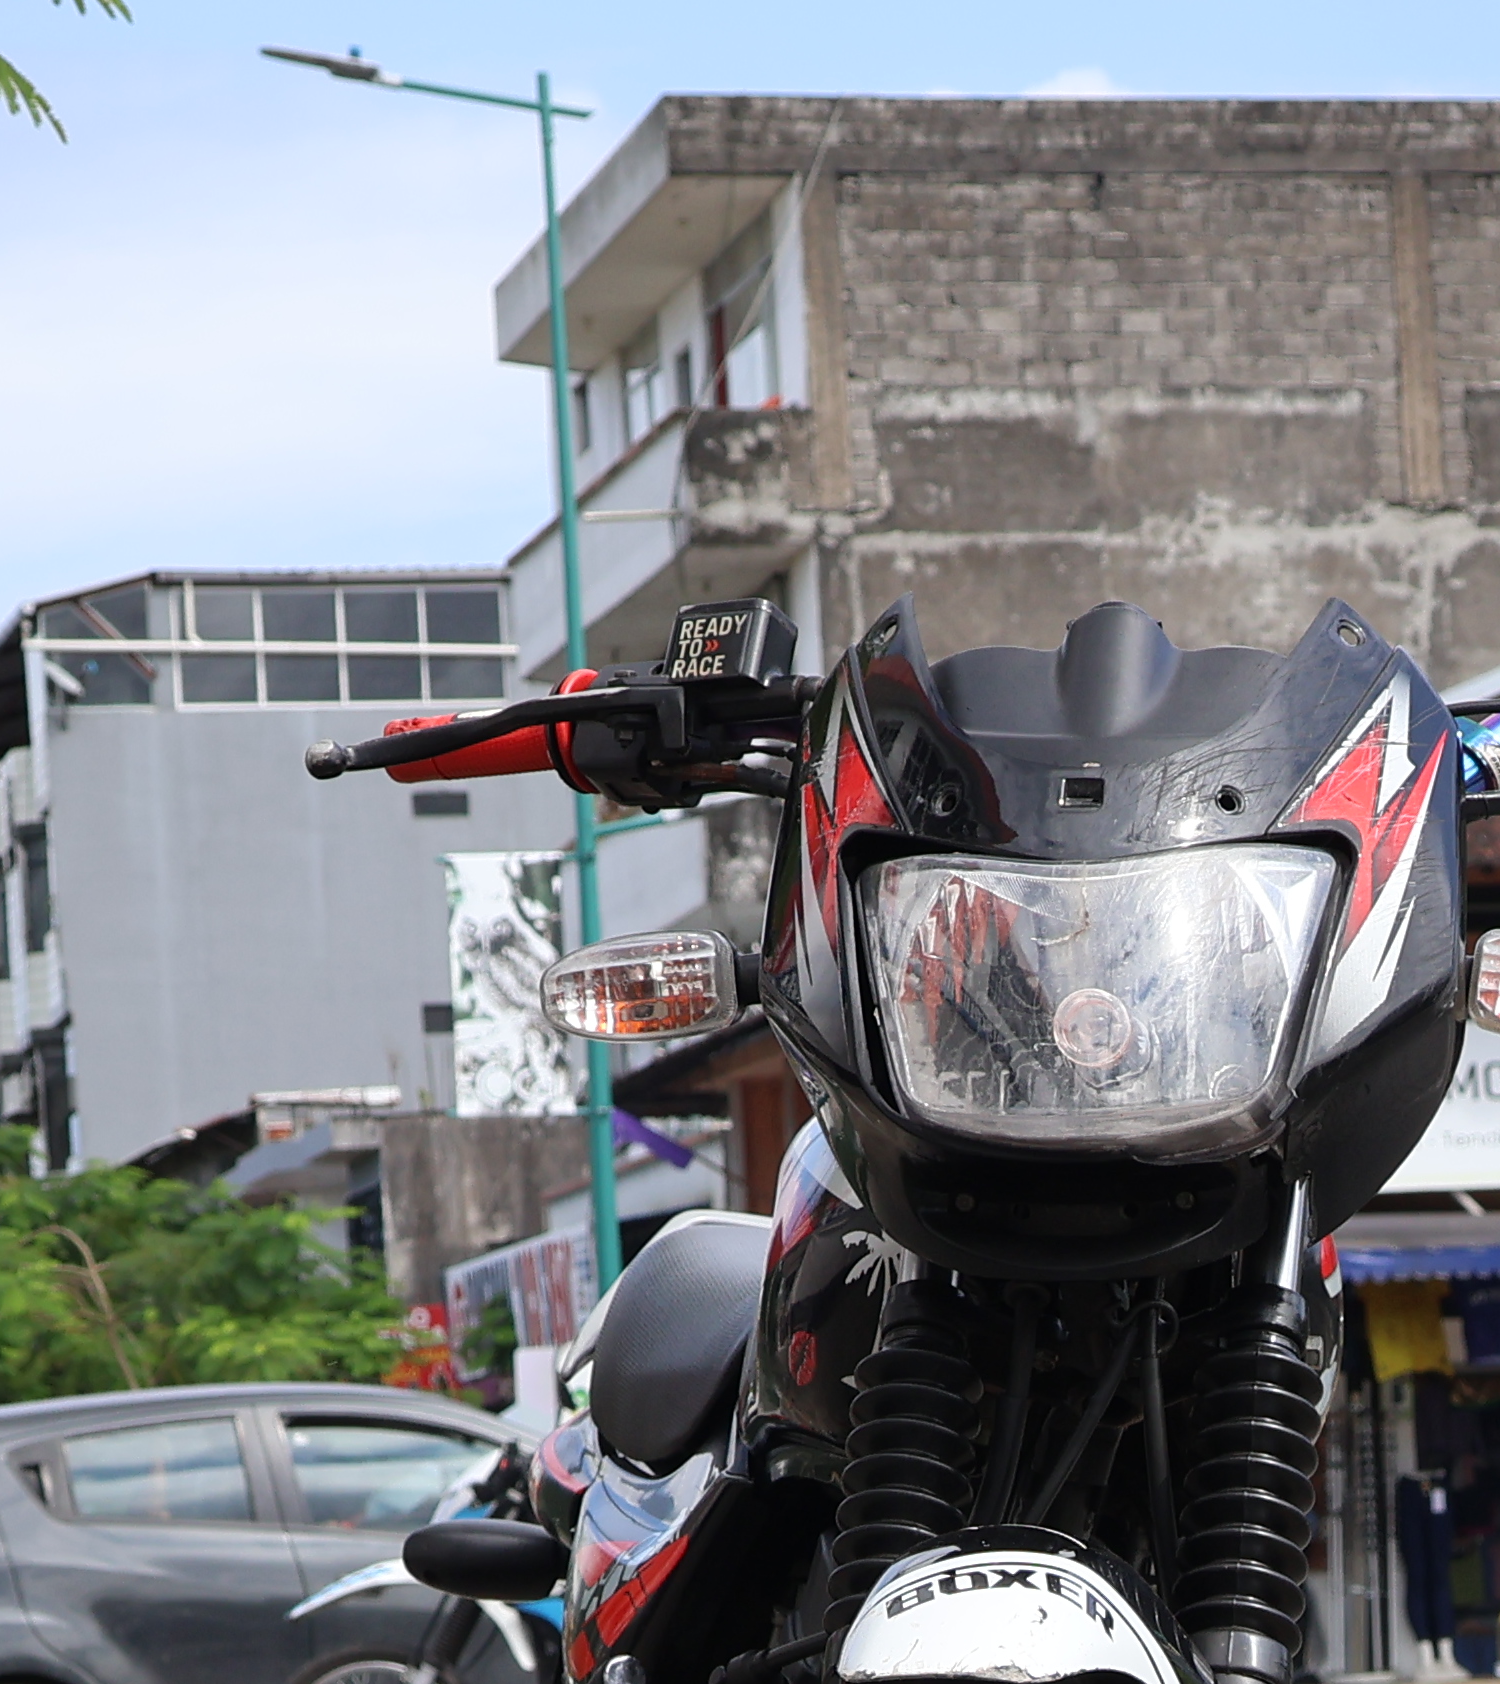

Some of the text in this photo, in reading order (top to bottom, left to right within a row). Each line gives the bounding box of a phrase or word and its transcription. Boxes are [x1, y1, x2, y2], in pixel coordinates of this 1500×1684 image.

[680, 614, 747, 639] READY
[679, 639, 703, 658] TO
[671, 655, 725, 678] RACE
[886, 1569, 1114, 1642] BOXER
